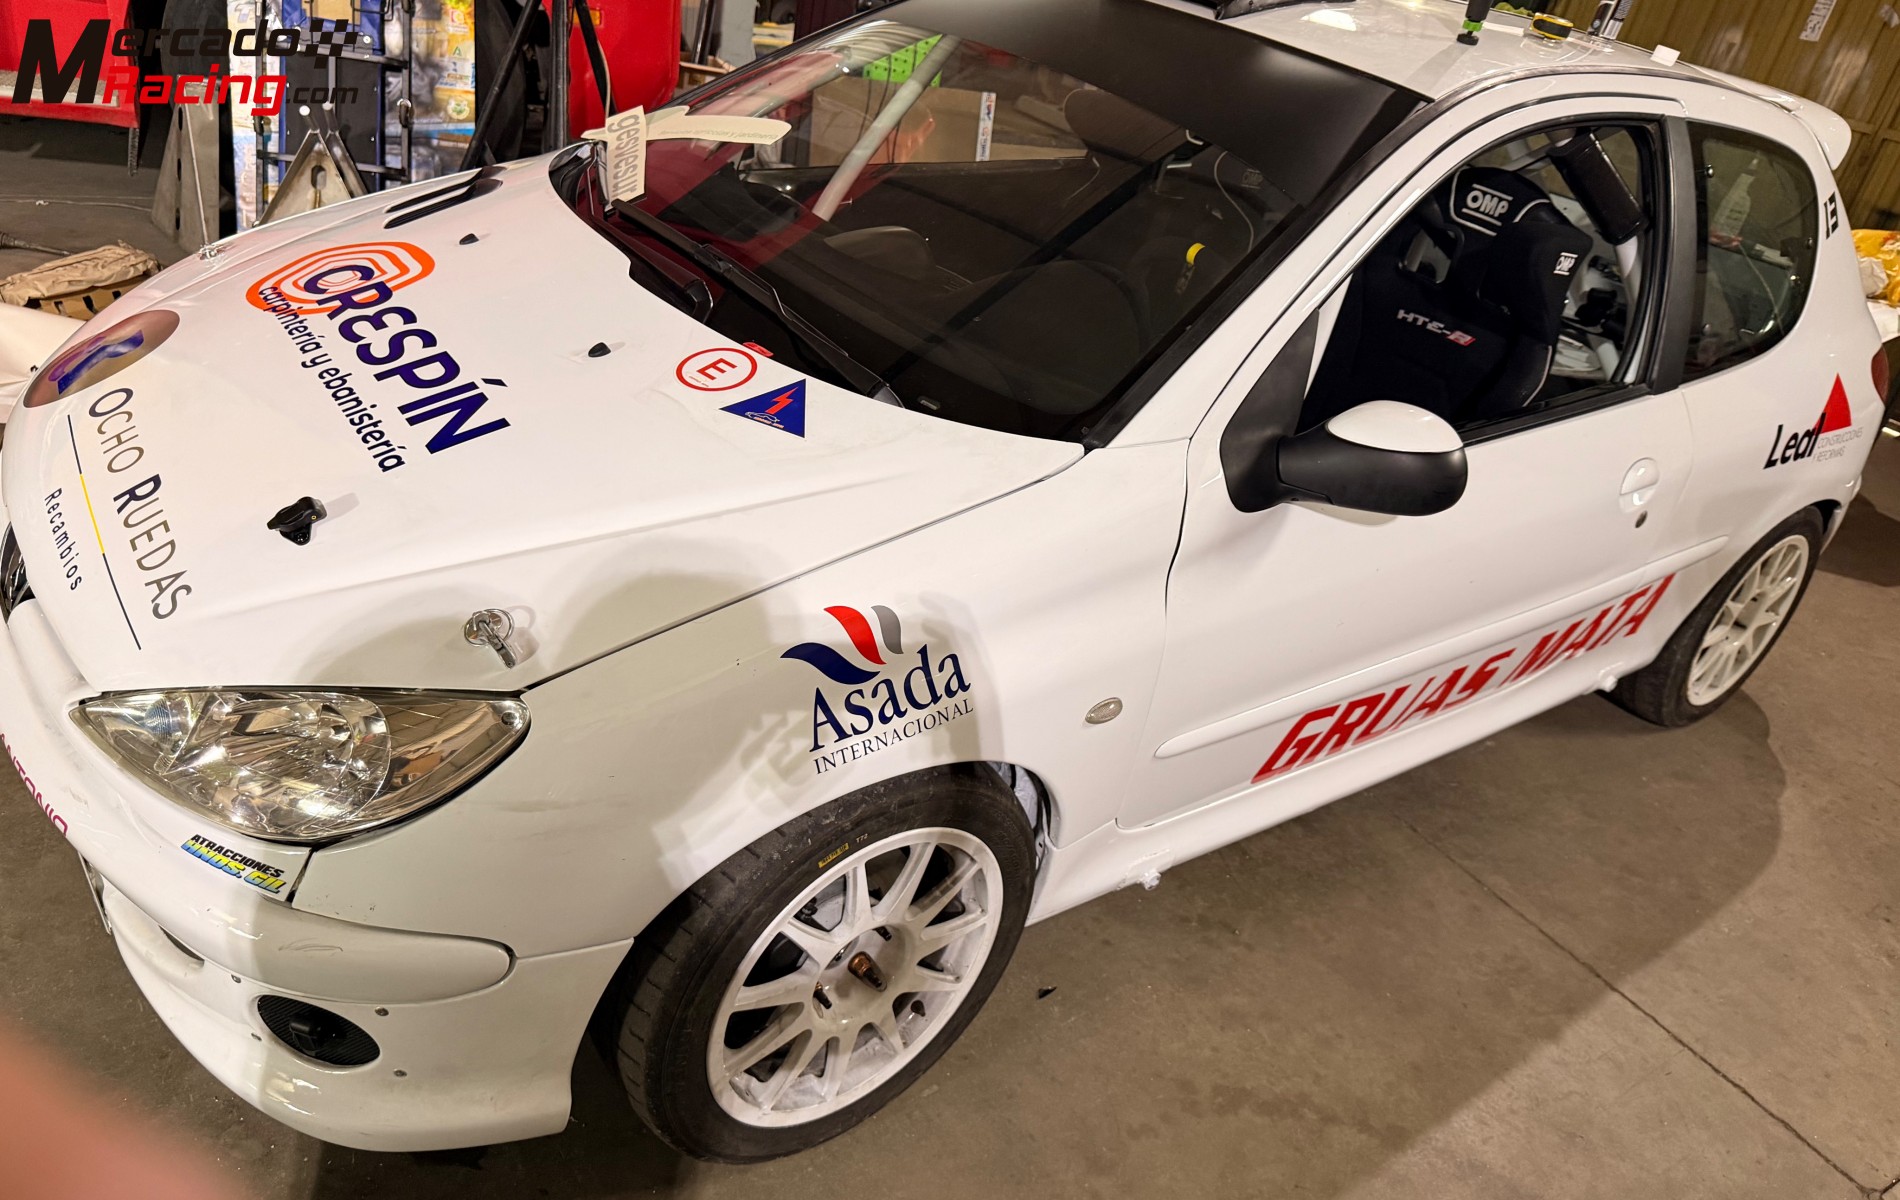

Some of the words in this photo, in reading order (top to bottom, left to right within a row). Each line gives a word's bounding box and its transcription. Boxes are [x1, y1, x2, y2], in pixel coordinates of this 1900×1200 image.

[1466, 189, 1510, 218] OMP
[1556, 255, 1576, 272] OMP
[303, 264, 511, 455] CRESPÍN
[1397, 309, 1476, 346] HTE-R
[258, 285, 326, 355] carpintería
[301, 353, 332, 370] y
[318, 372, 406, 473] ebanistería
[696, 357, 738, 381] E
[88, 387, 145, 474] OCHO
[1763, 411, 1826, 470] Leal
[44, 487, 82, 591] Recambios
[113, 473, 192, 620] RUEDAS
[809, 643, 971, 753] Asada
[1251, 648, 1517, 785] GRUAS
[1499, 572, 1677, 688] MATA
[813, 698, 974, 775] INTERNACIONAL
[190, 834, 285, 878] ATRACCIONES
[243, 870, 287, 894] GIL
